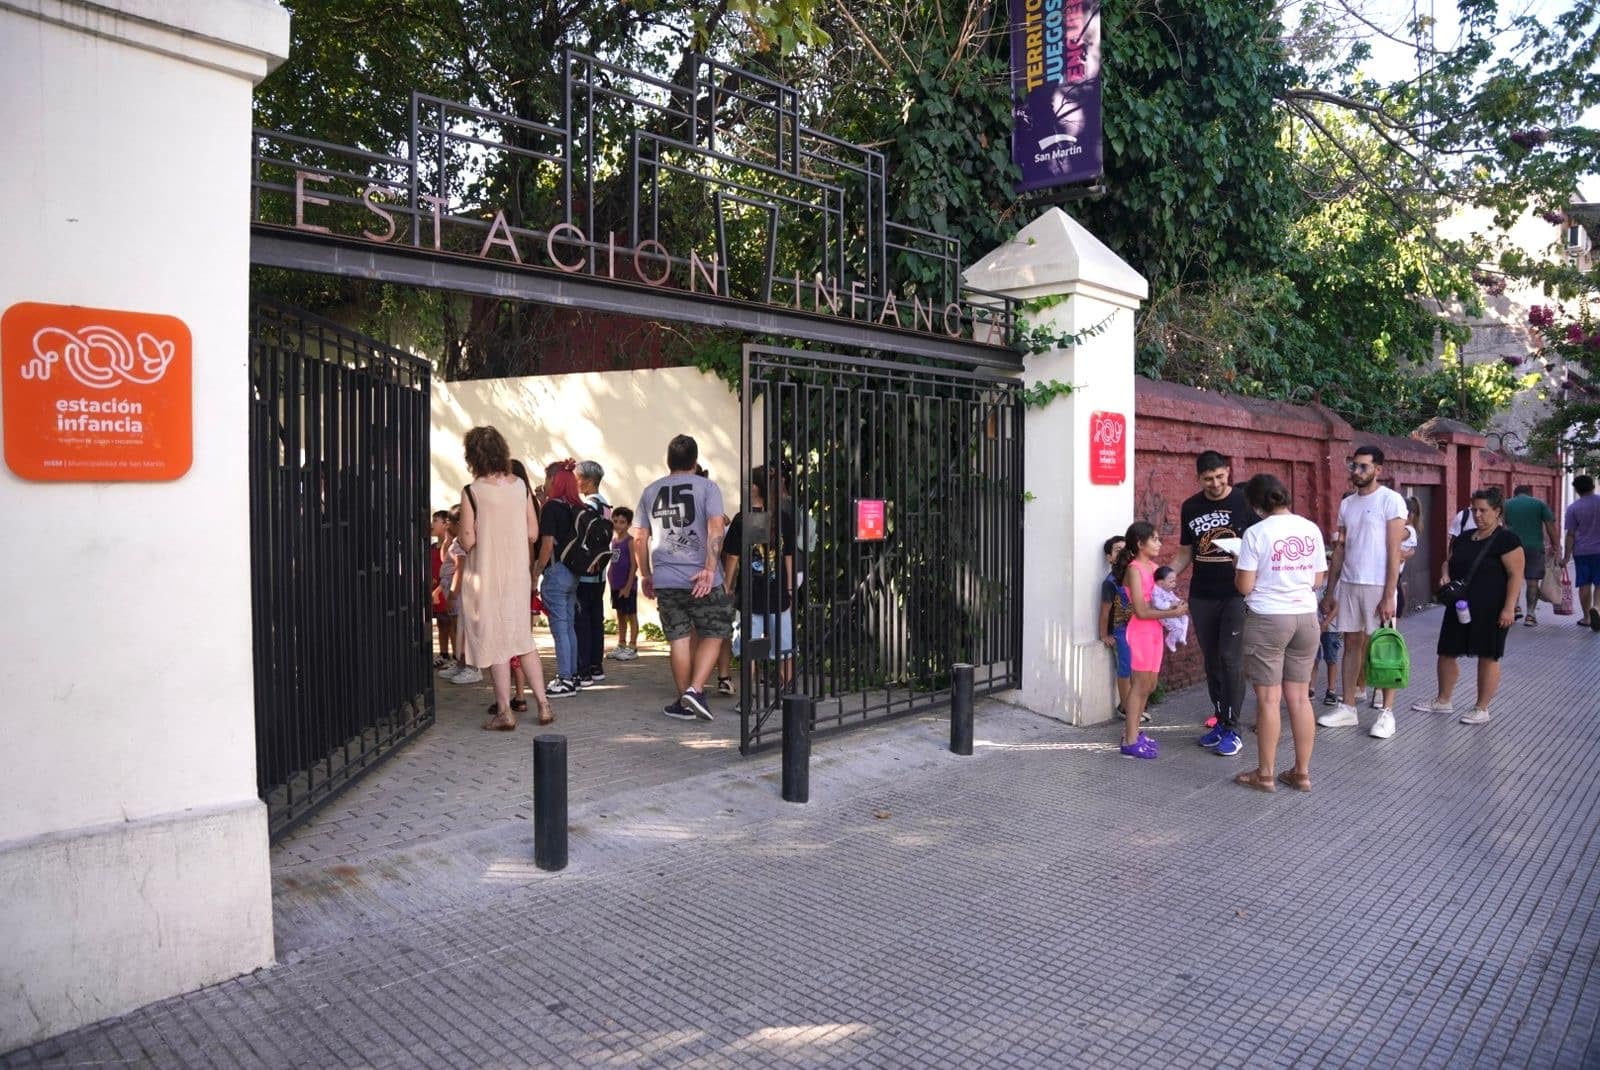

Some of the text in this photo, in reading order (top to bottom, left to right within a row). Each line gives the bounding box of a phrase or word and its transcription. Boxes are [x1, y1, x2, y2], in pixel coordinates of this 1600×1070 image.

[1045, 0, 1064, 84] JUEGOS
[1034, 153, 1051, 163] San
[296, 170, 1005, 348] ESTACION INFANCIA
[56, 397, 143, 414] estación
[57, 414, 143, 432] infancia
[652, 483, 696, 530] 45
[1188, 512, 1231, 530] FRESH
[1194, 518, 1230, 536] FOOD
